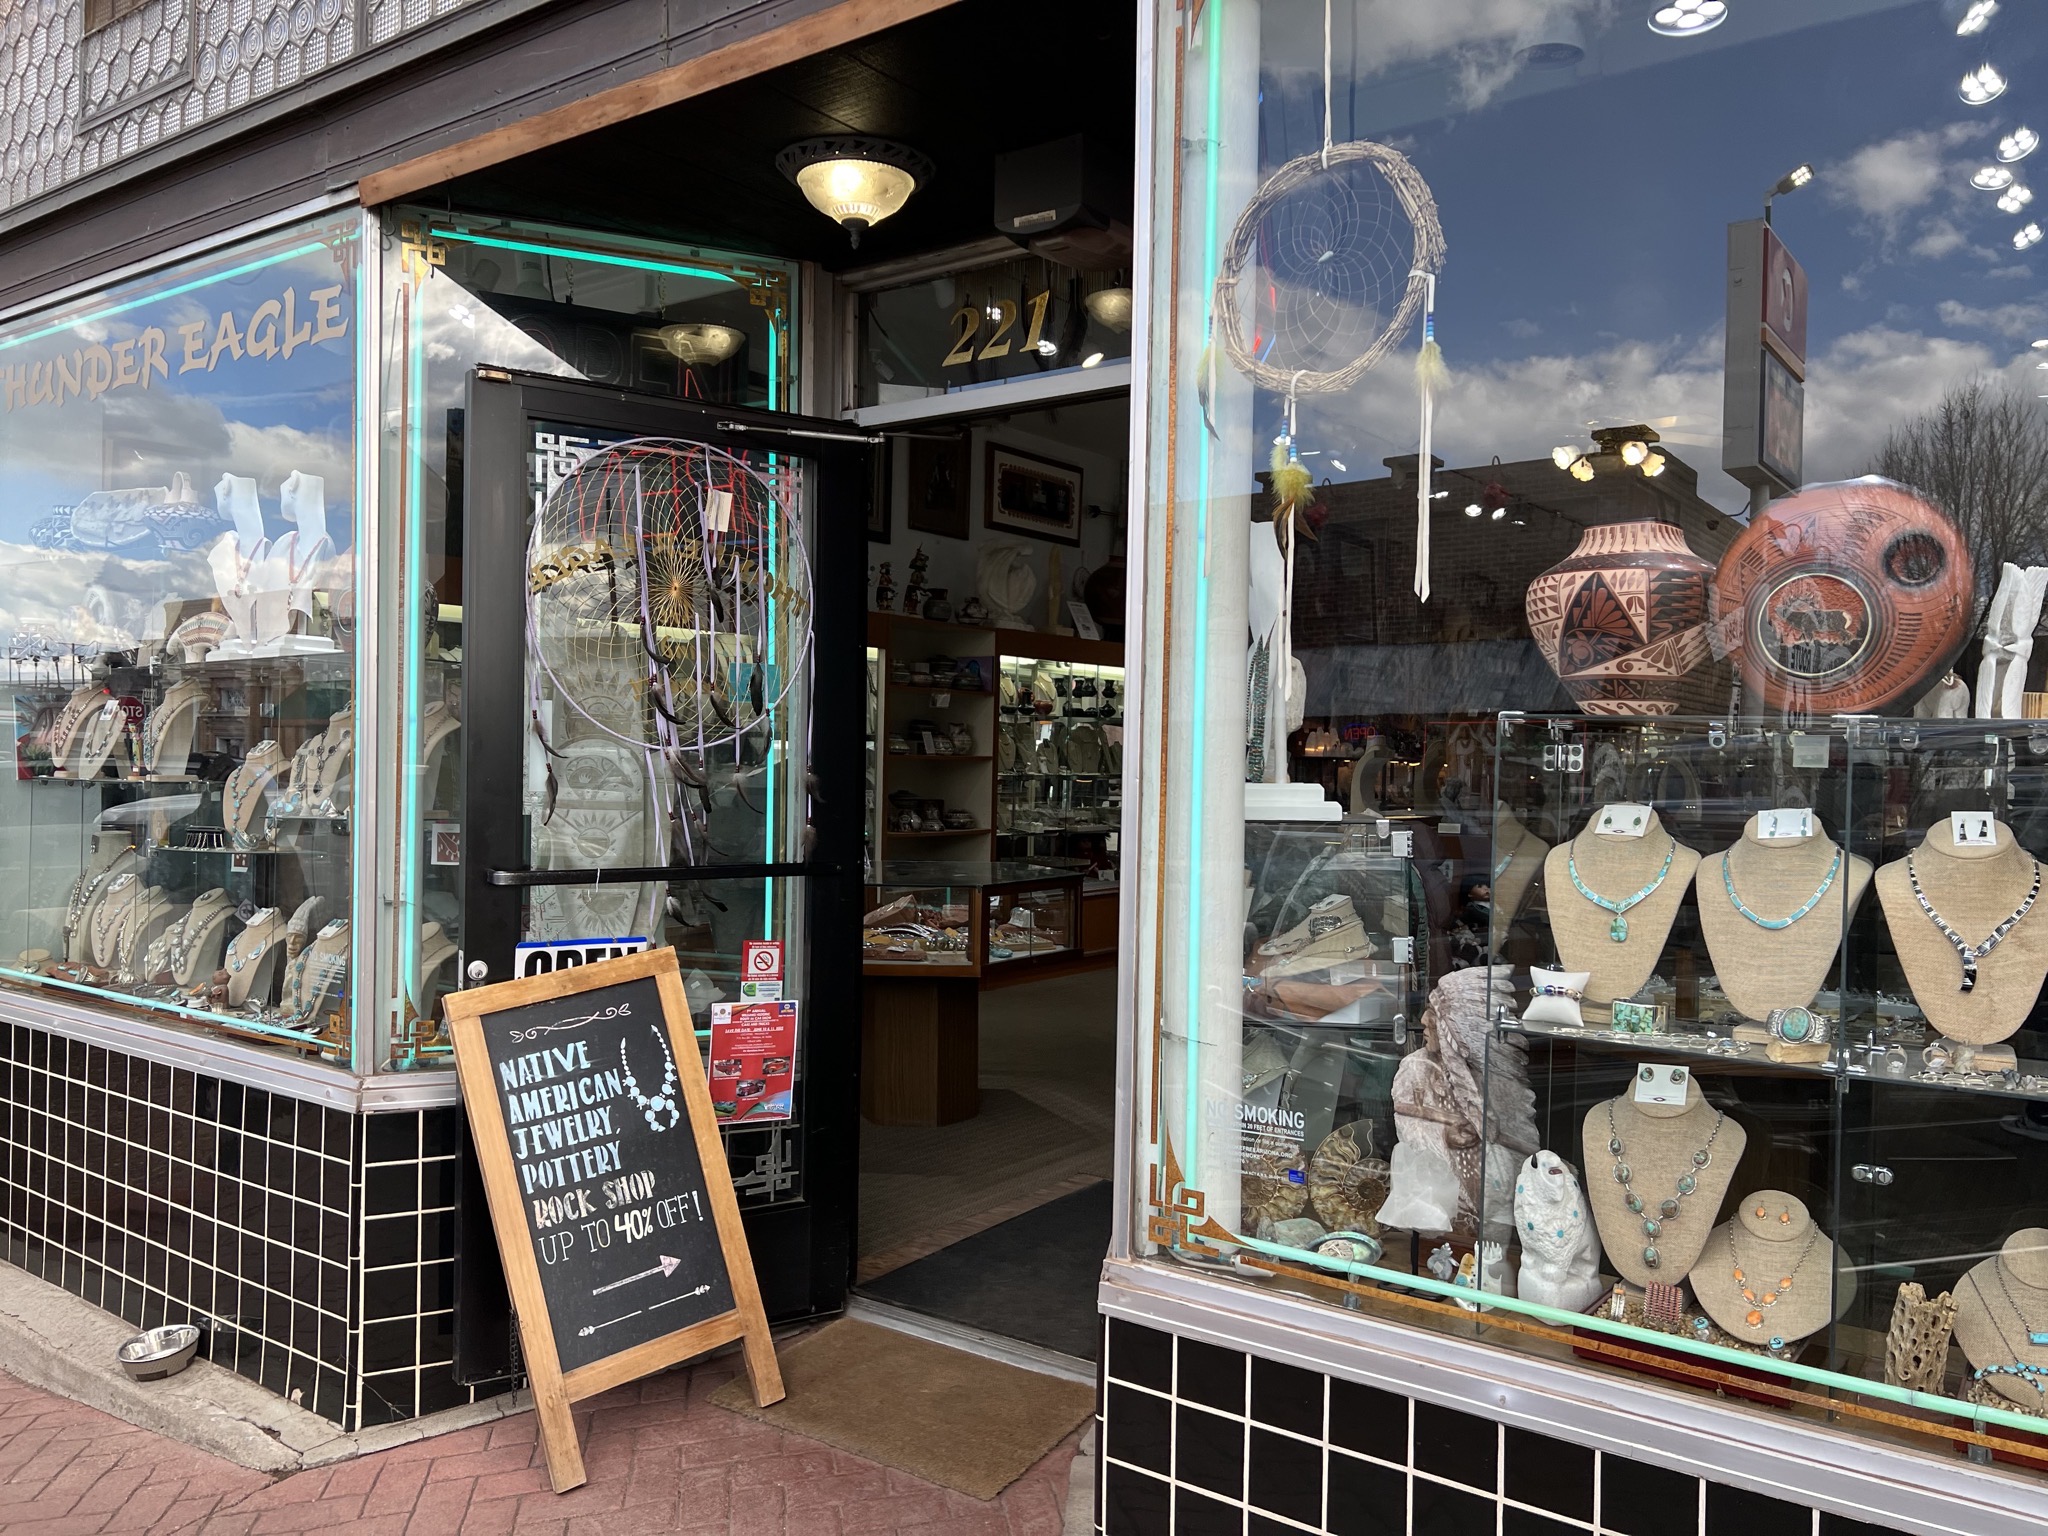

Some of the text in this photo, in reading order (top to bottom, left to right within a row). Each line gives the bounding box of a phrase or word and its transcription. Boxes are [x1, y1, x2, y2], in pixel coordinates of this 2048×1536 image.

[178, 284, 349, 375] EAGLE
[942, 290, 1050, 367] 221
[524, 947, 638, 978] OP
[499, 1040, 591, 1091] NATIVE
[508, 1068, 623, 1124] AMERICAN
[1234, 1103, 1305, 1129] SMOKING
[513, 1105, 621, 1159] JEWELRY,
[1274, 1127, 1304, 1138] ENTRANCES
[521, 1140, 622, 1195] POTTERY
[532, 1169, 656, 1230] ROCK SHOP
[538, 1231, 574, 1265] UP
[580, 1219, 612, 1253] TO
[614, 1206, 654, 1244] 40%
